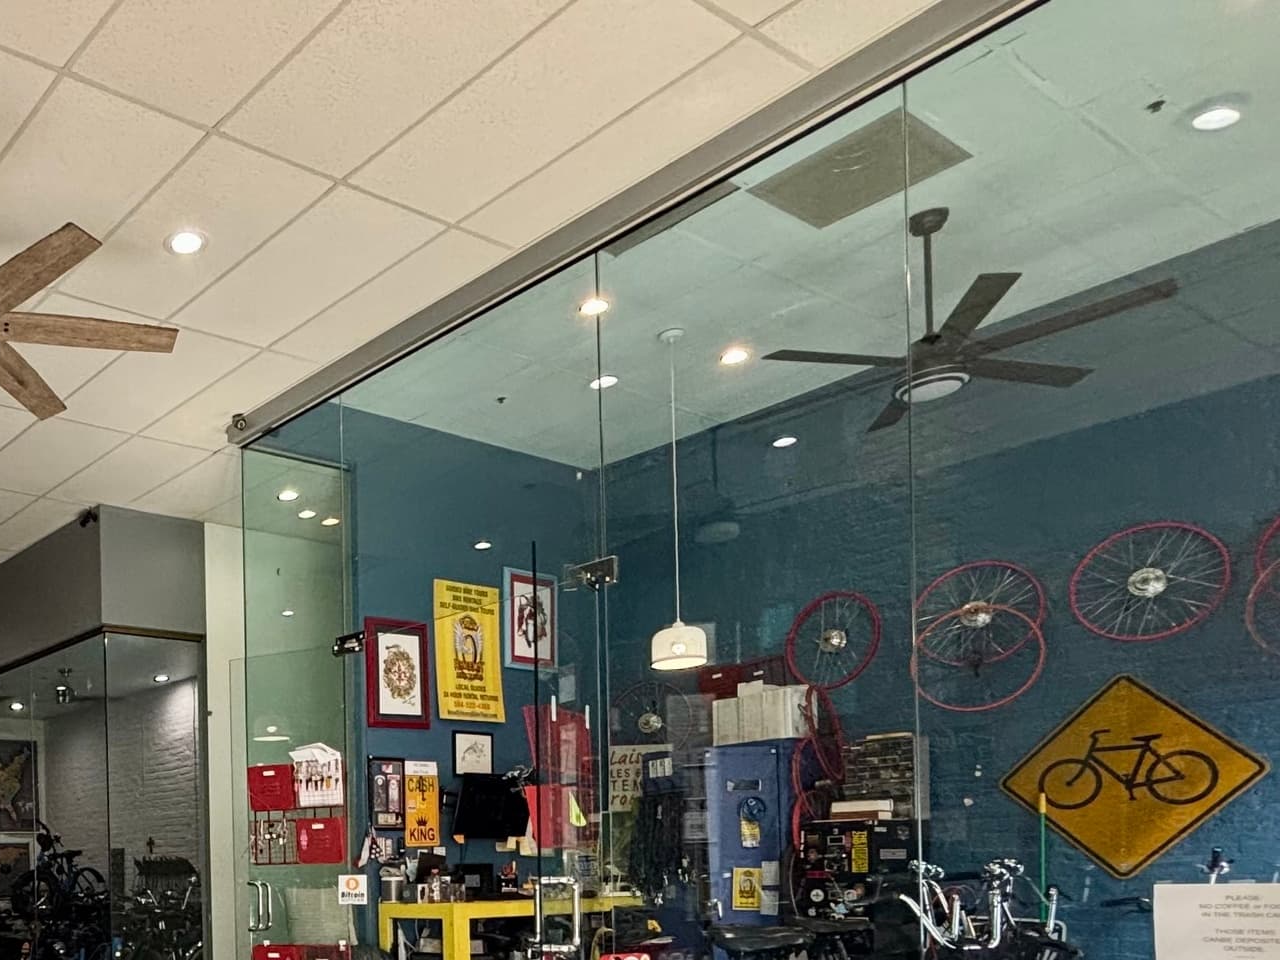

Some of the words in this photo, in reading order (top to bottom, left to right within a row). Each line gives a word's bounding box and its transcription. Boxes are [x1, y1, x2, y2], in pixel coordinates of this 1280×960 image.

[407, 778, 435, 793] CASH
[409, 827, 436, 841] KING
[341, 891, 365, 899] Bitcoin
